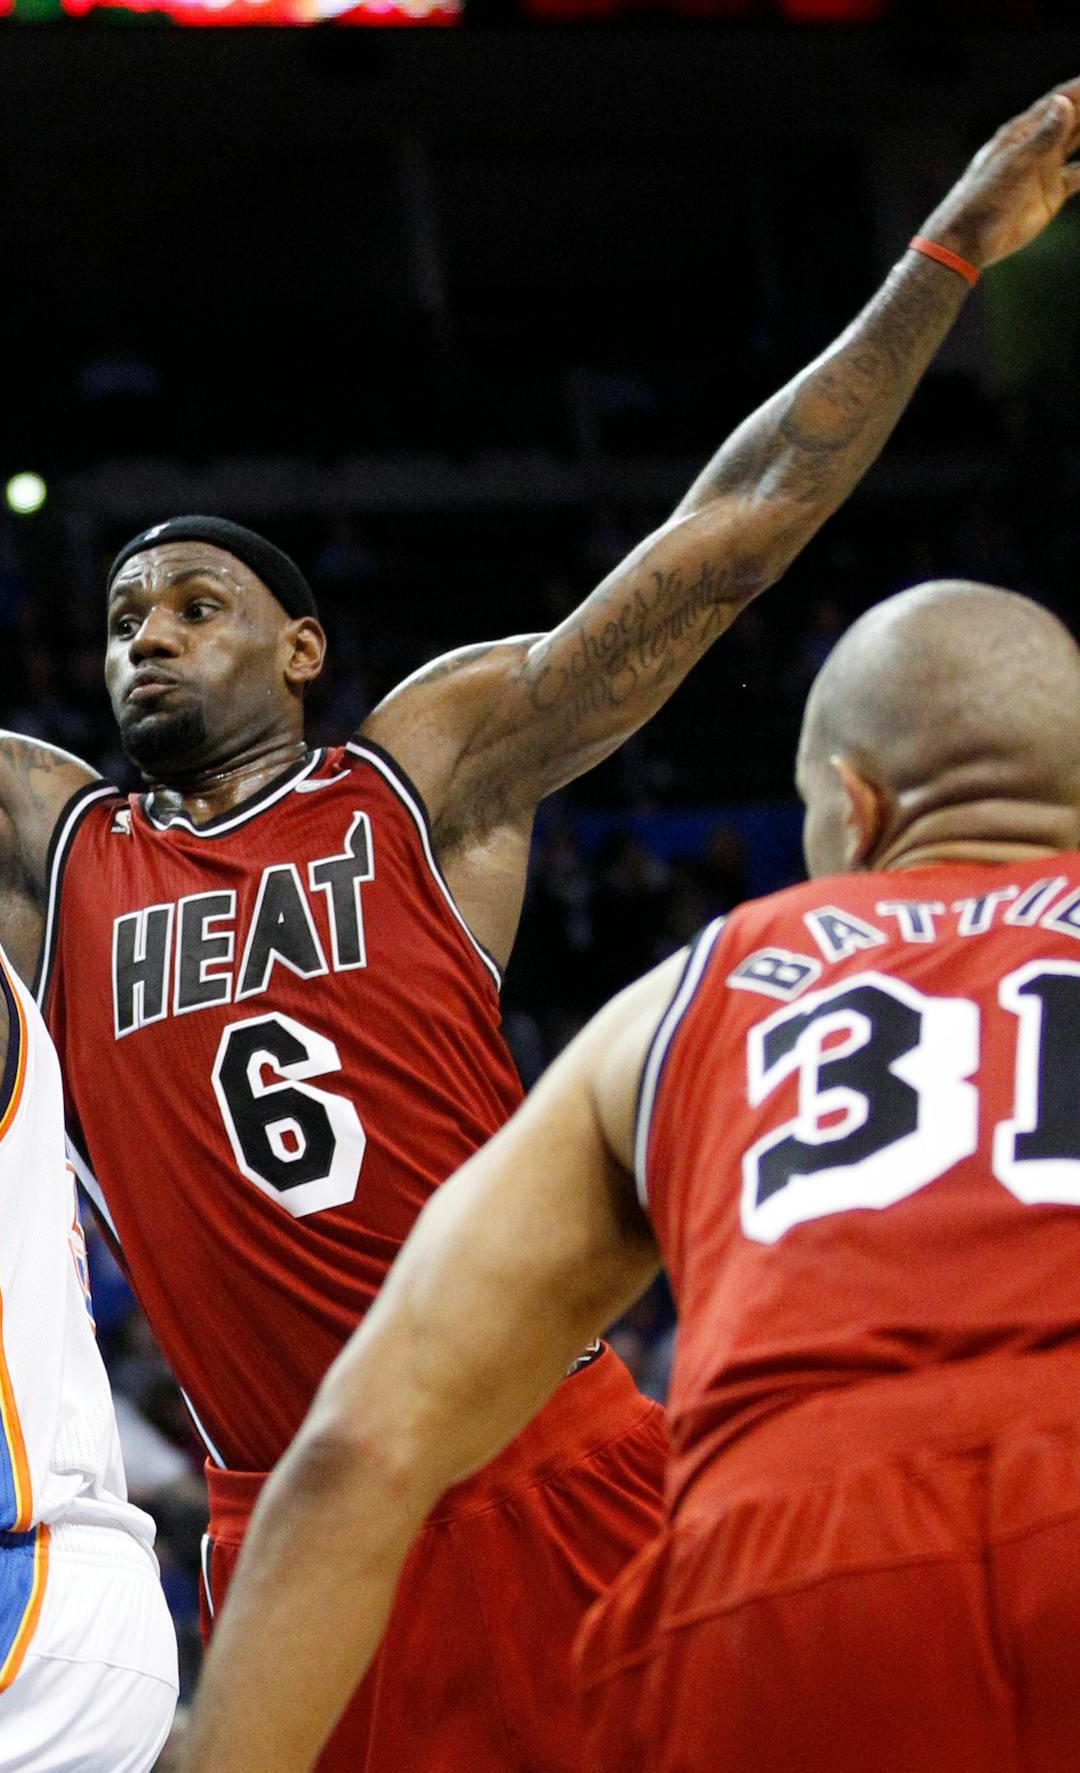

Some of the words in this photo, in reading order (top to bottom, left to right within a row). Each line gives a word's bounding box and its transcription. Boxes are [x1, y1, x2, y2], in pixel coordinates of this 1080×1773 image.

[111, 810, 375, 1040] HEAT
[210, 1011, 366, 1218] 6
[740, 958, 1080, 1245] 31
